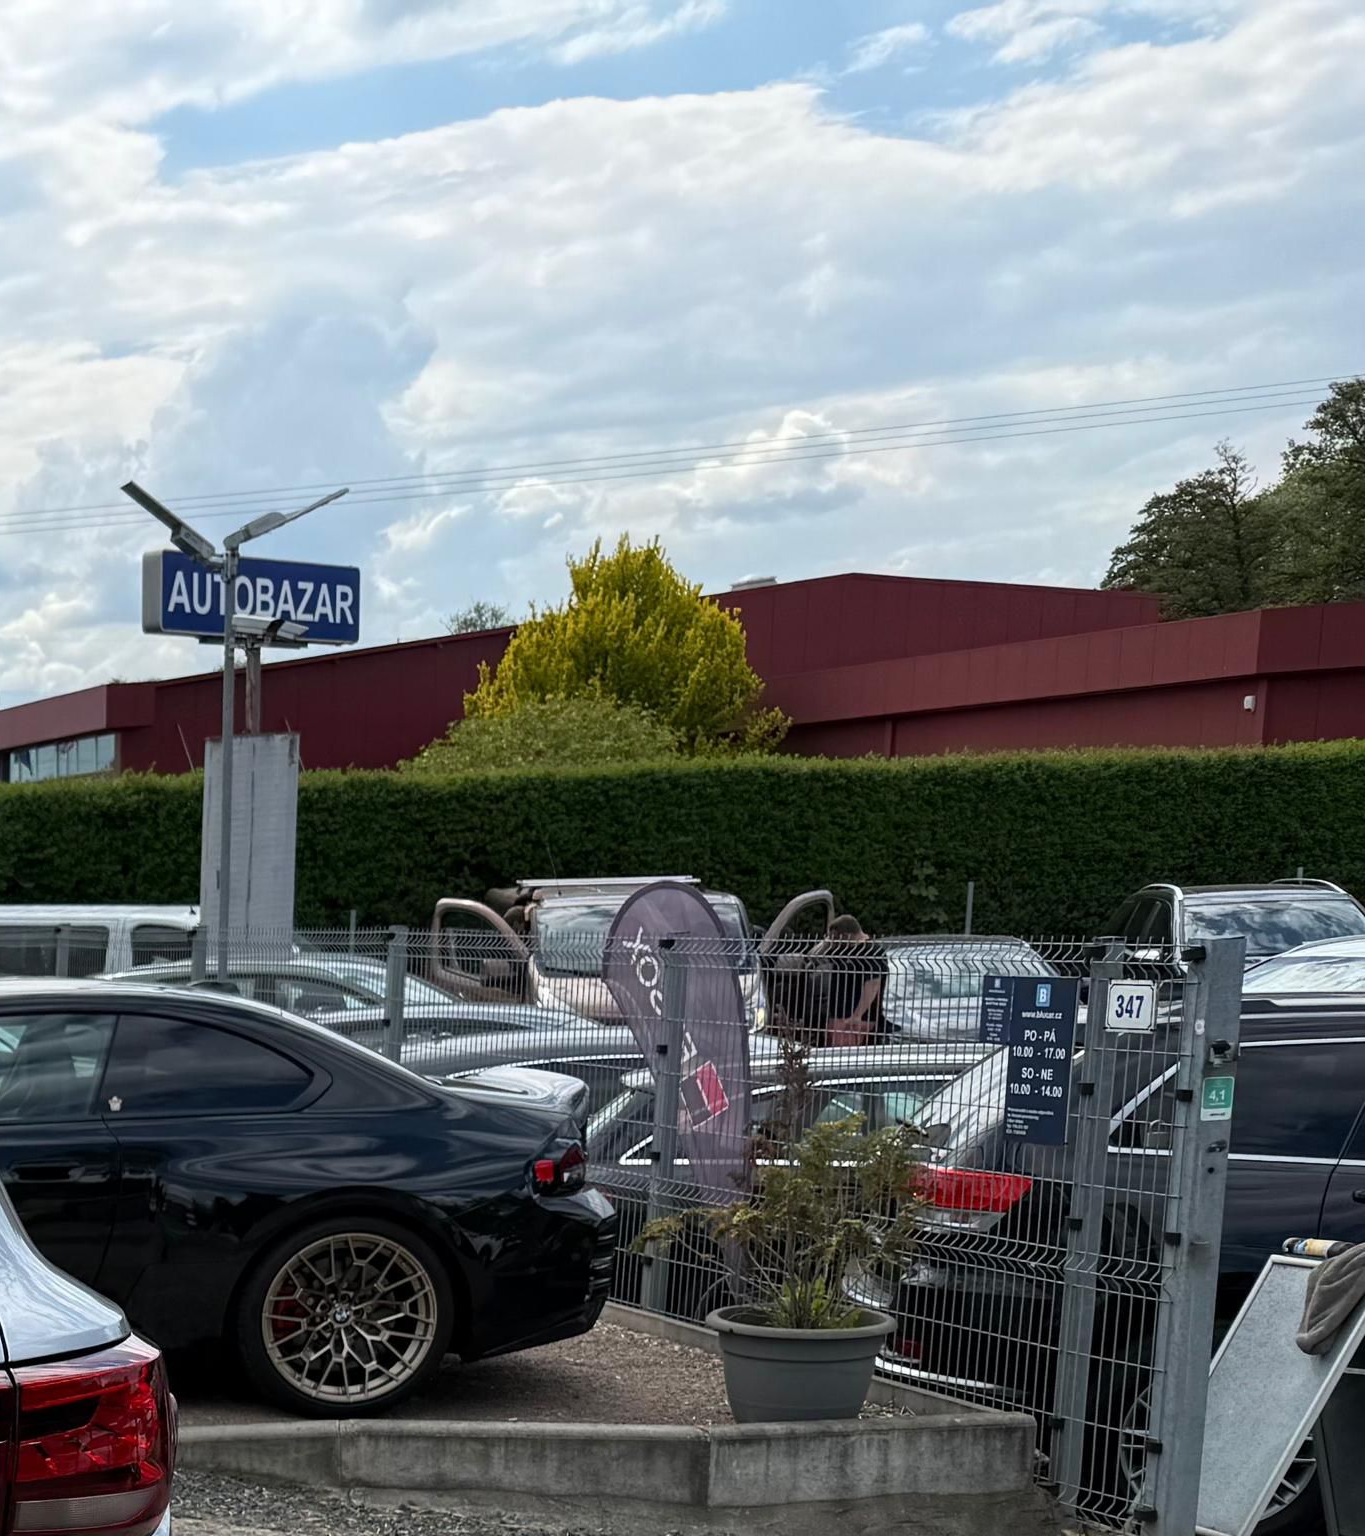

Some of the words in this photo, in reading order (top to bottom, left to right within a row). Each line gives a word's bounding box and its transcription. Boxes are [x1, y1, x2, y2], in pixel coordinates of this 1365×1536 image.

[167, 570, 355, 625] AUTOBAZAR
[1115, 994, 1145, 1019] 347
[1021, 1011, 1063, 1020] www.blucar.cz
[1024, 1030, 1037, 1042] PO
[1043, 1028, 1056, 1043] PÁ
[1013, 1045, 1034, 1058] 10.00
[1044, 1047, 1066, 1060] 17.00
[1021, 1067, 1035, 1079] SO
[1040, 1068, 1054, 1081] NE
[1010, 1083, 1031, 1095] 10.00
[1041, 1085, 1063, 1098] 14.00
